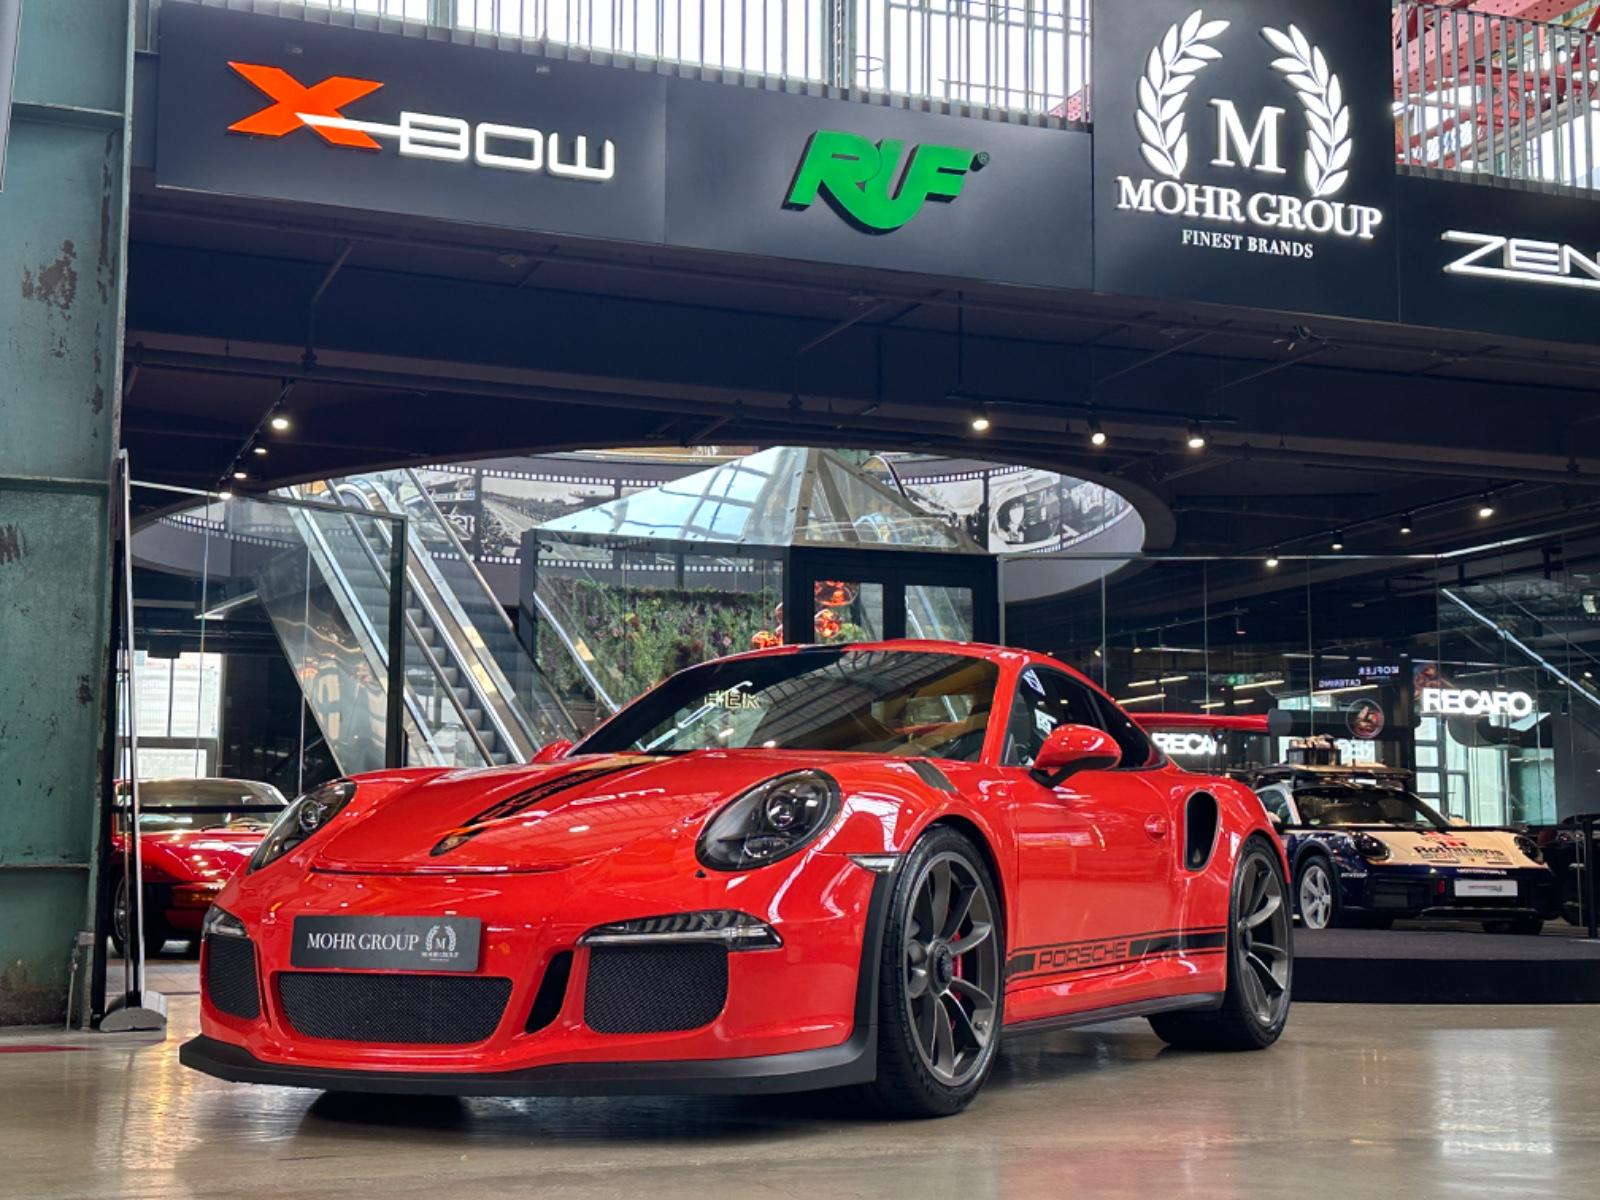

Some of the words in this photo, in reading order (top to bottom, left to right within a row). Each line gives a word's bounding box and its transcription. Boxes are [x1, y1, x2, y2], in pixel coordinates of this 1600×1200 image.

[1209, 98, 1286, 174] M
[1116, 176, 1245, 222] MOHR
[1249, 192, 1383, 239] GROUP
[1182, 229, 1243, 250] FINEST
[1247, 236, 1314, 258] BRANDS
[1422, 687, 1533, 717] RECARO
[307, 933, 356, 950] MOHR
[358, 934, 420, 950] GROUP
[1039, 942, 1126, 970] PORSCHE
